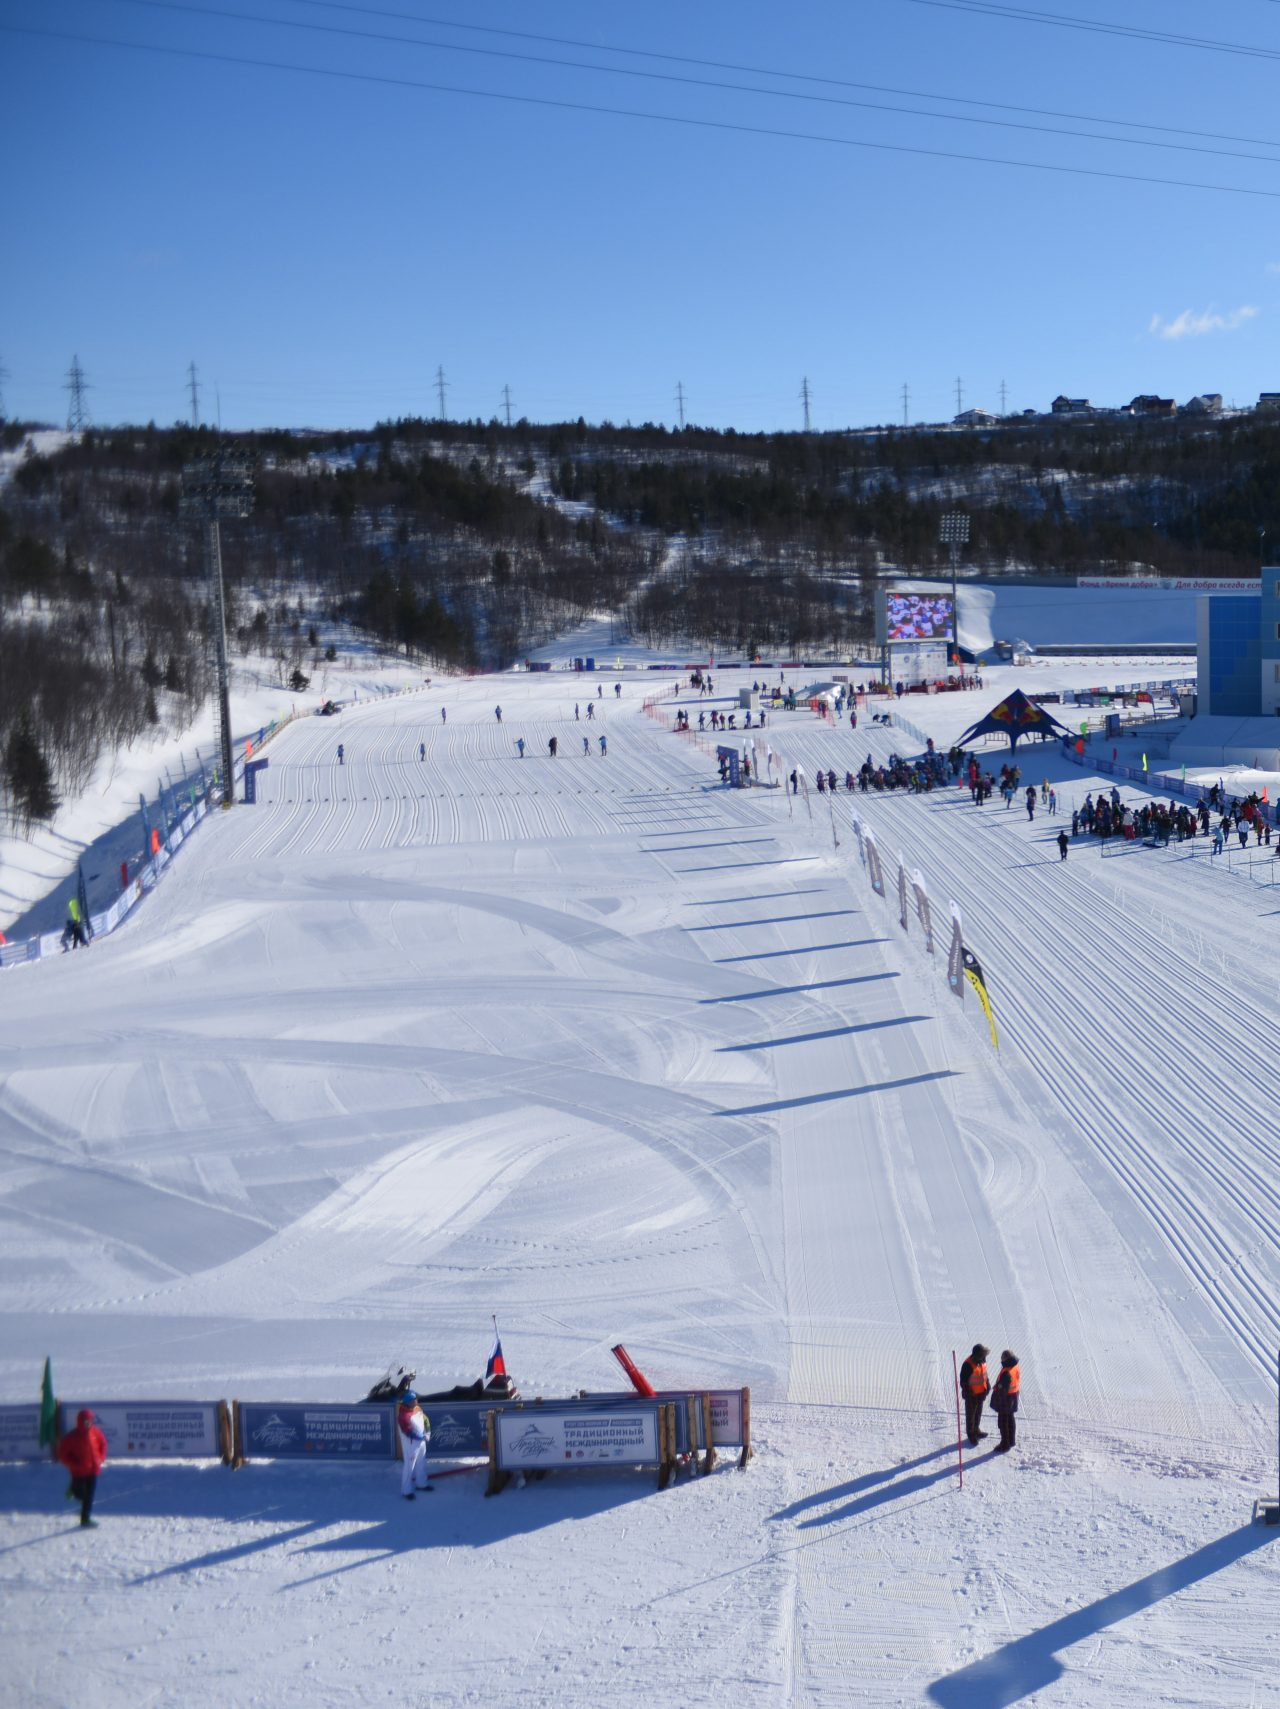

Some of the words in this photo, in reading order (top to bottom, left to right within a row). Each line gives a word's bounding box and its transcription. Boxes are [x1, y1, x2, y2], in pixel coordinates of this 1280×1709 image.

[1175, 581, 1191, 589] Для
[1193, 581, 1217, 590] добра
[1219, 581, 1245, 589] всегда
[305, 1422, 382, 1431] ТРАДИЦИОННЫЙ
[564, 1427, 644, 1438] ТРАДИЦИОННЫЙ
[565, 1436, 645, 1448] МЕЖДУНАРОДНЫЙ
